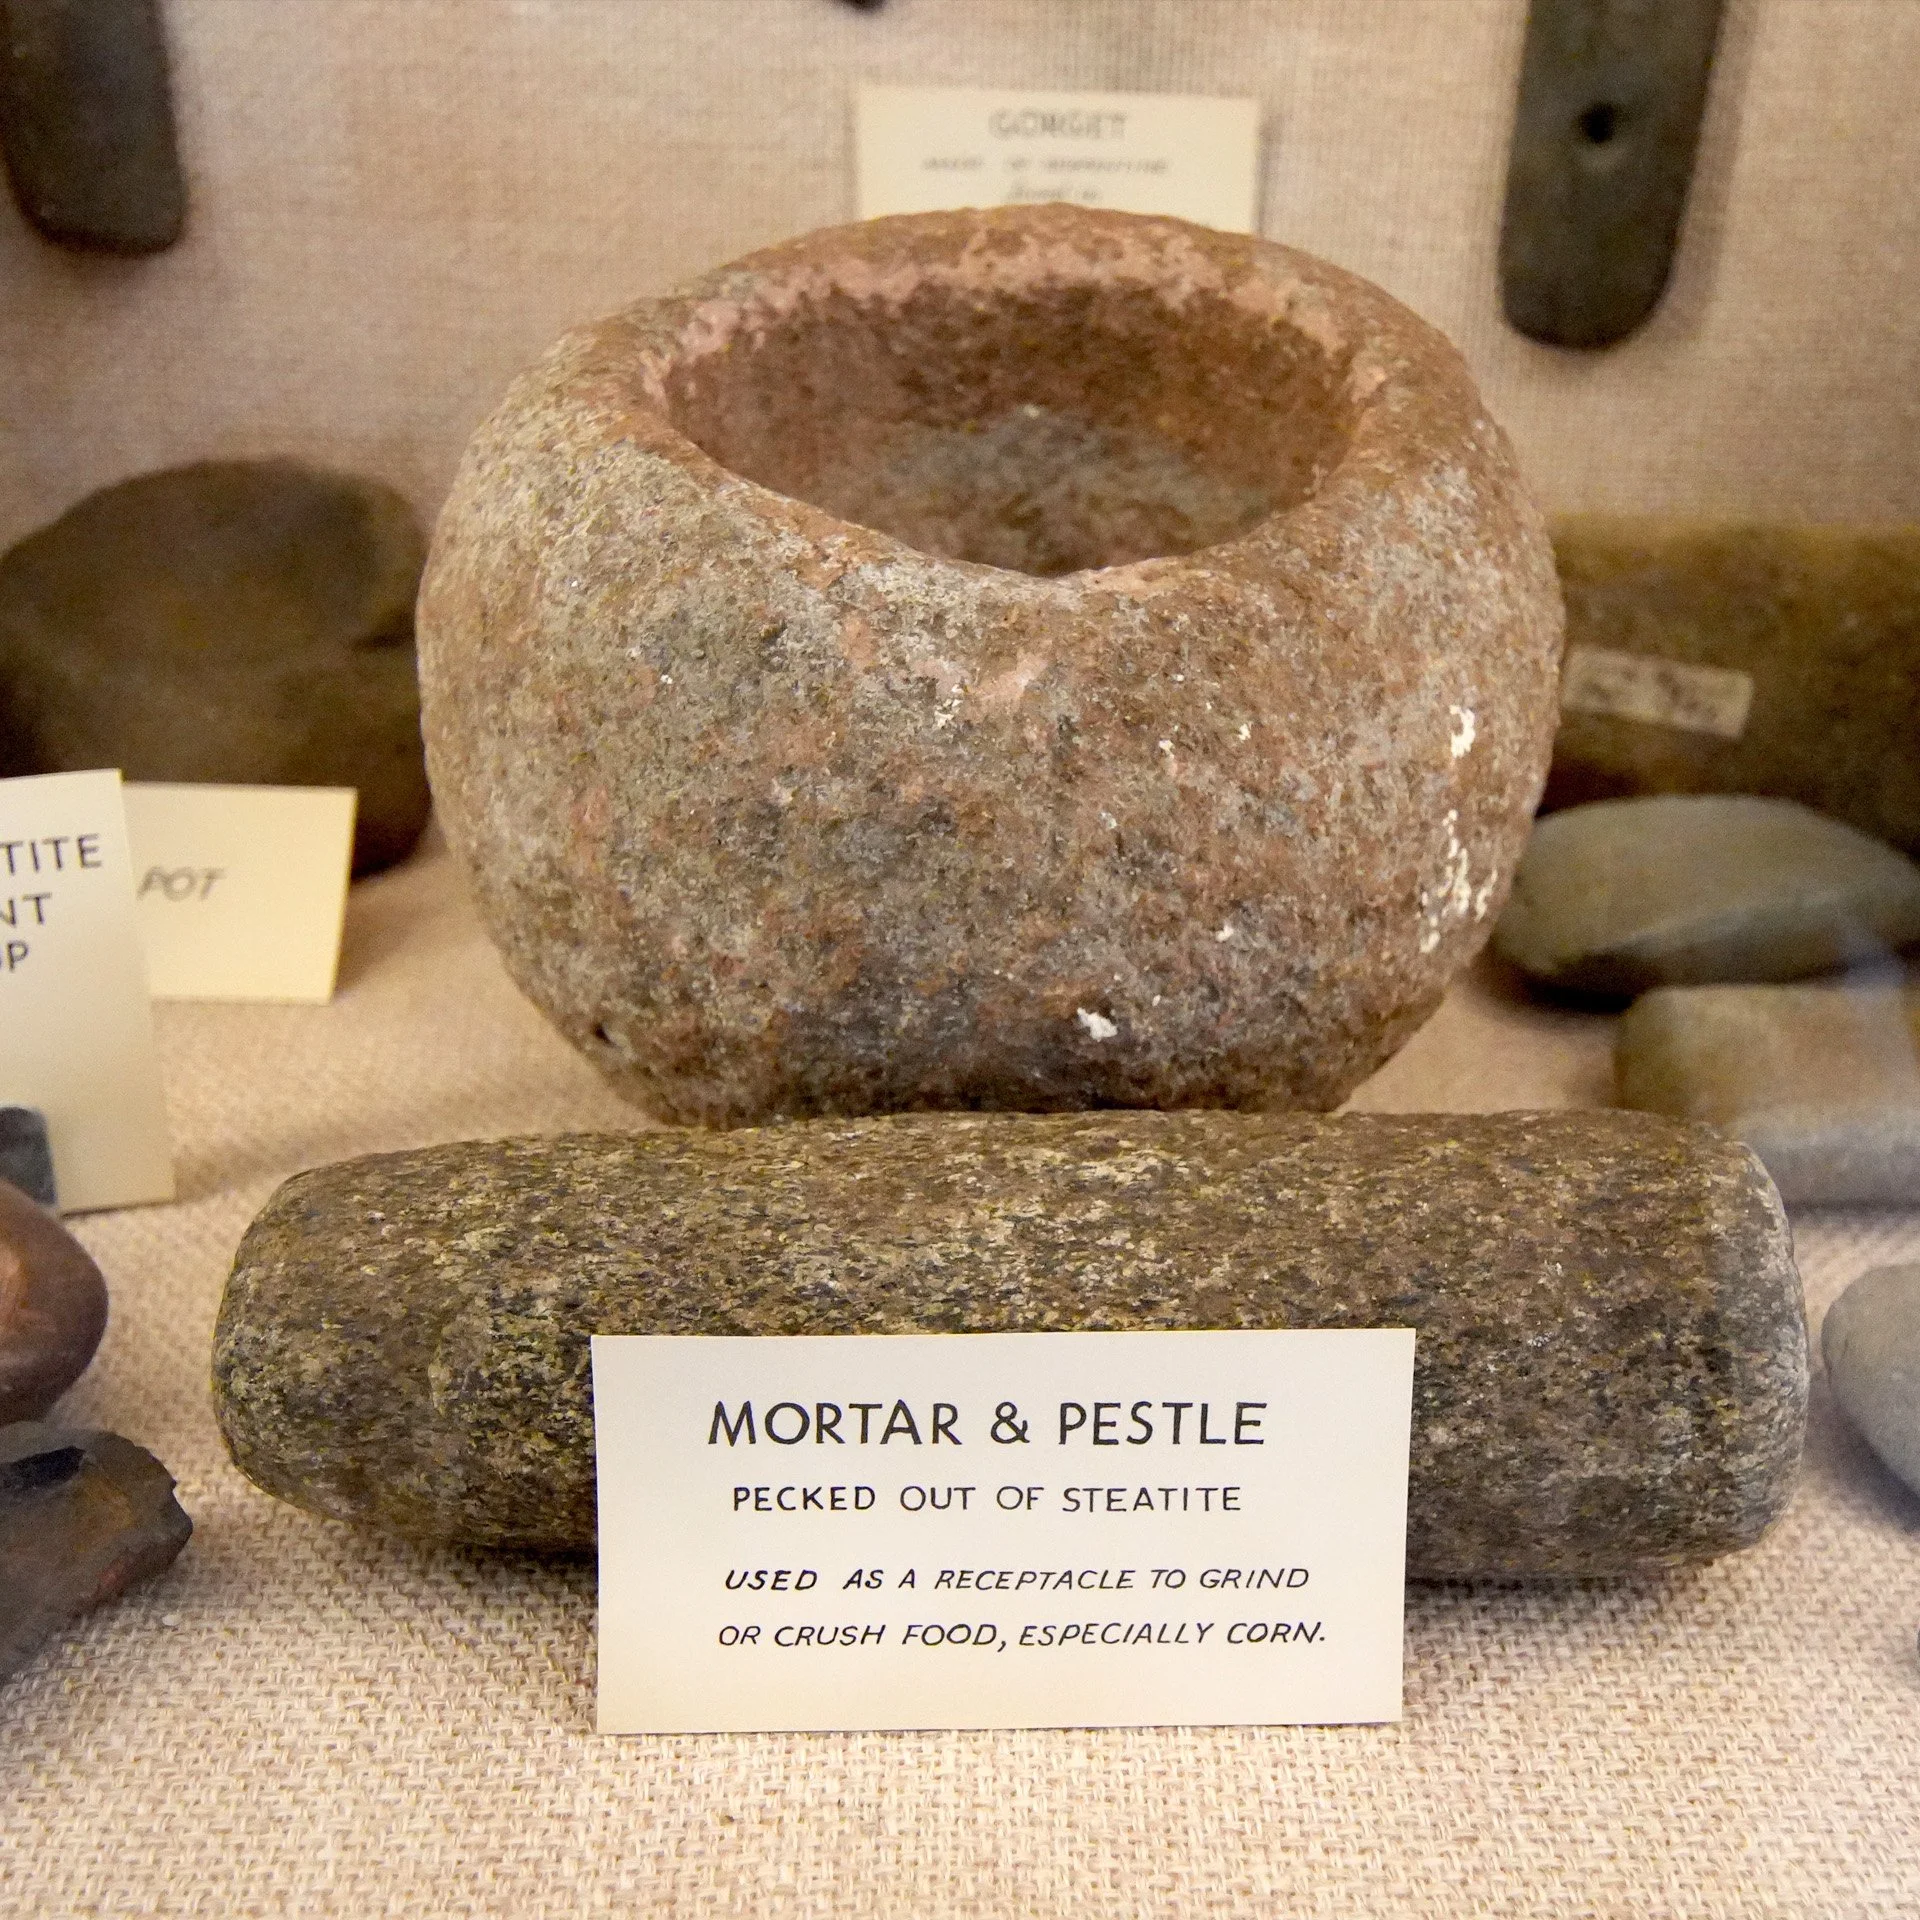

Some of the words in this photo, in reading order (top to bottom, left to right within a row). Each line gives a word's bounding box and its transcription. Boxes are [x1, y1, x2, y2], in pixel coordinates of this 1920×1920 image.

[136, 865, 226, 902] POT
[708, 1399, 962, 1447] MORTAR
[990, 1402, 1030, 1445] &
[1058, 1401, 1268, 1445] PESTLE
[734, 1486, 876, 1512] PECKED
[900, 1486, 976, 1511] OUT
[996, 1486, 1044, 1511] OF
[1062, 1487, 1242, 1513] STEATITE
[725, 1569, 817, 1591] USED
[842, 1569, 884, 1591] AS
[898, 1569, 915, 1590] A
[934, 1570, 1136, 1591] RECEPTACLE
[1151, 1569, 1186, 1590] TO
[1200, 1568, 1310, 1590] GRIND
[719, 1624, 761, 1647] OR
[774, 1624, 886, 1647] CRUSH
[902, 1624, 1008, 1653] FOOD,
[1019, 1622, 1214, 1647] ESPECIALLY
[1227, 1622, 1326, 1645] CORN.
